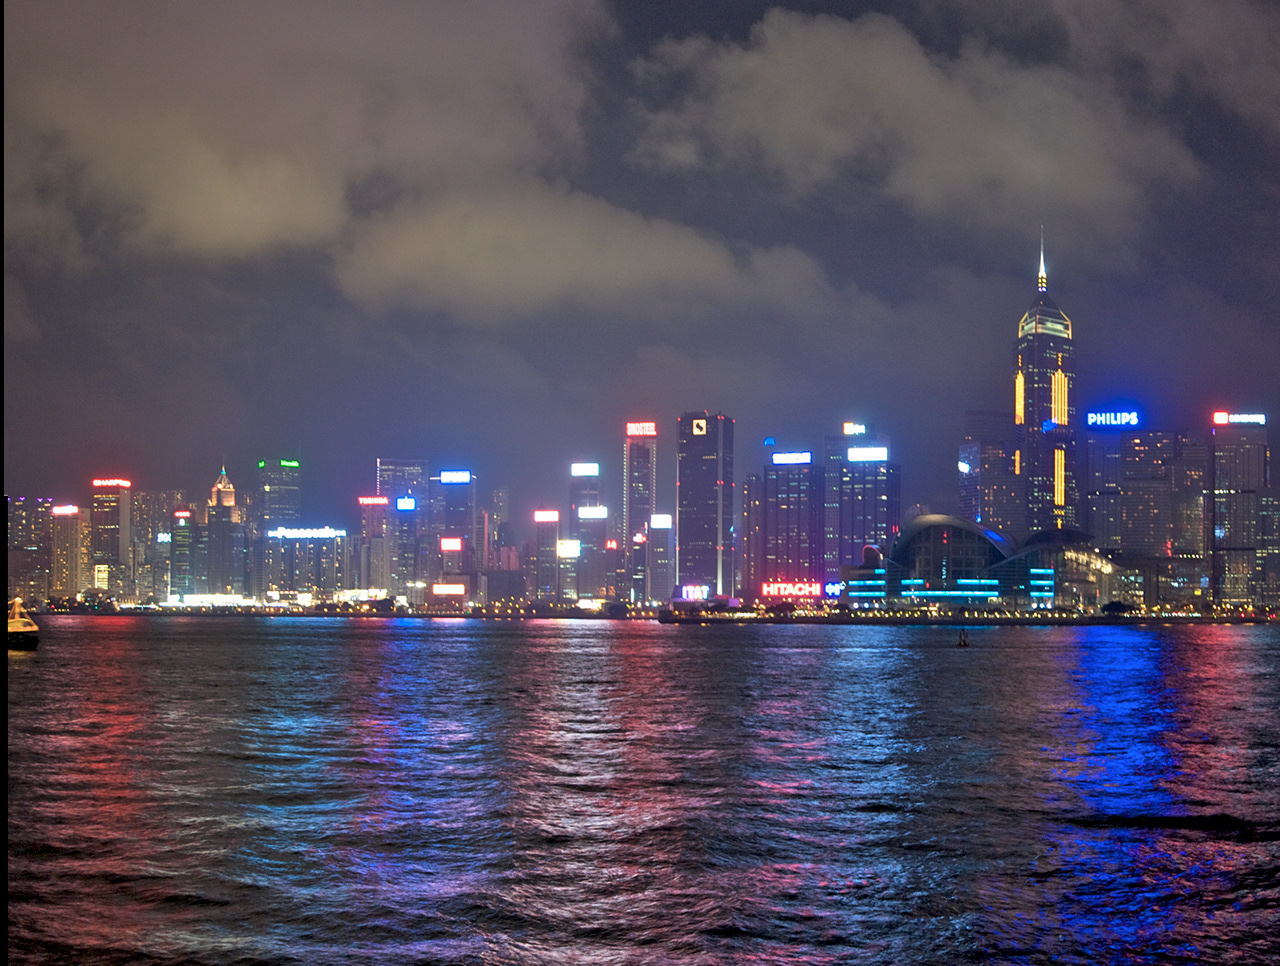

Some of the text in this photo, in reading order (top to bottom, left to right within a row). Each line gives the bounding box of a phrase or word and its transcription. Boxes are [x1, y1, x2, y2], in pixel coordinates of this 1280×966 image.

[1087, 411, 1139, 426] PHILIPS
[626, 422, 657, 436] SINOSTEEL
[358, 496, 388, 505] TOSHIBA
[277, 525, 336, 539] Panasonic
[682, 585, 710, 600] ITAT
[761, 582, 821, 597] HITACHI
